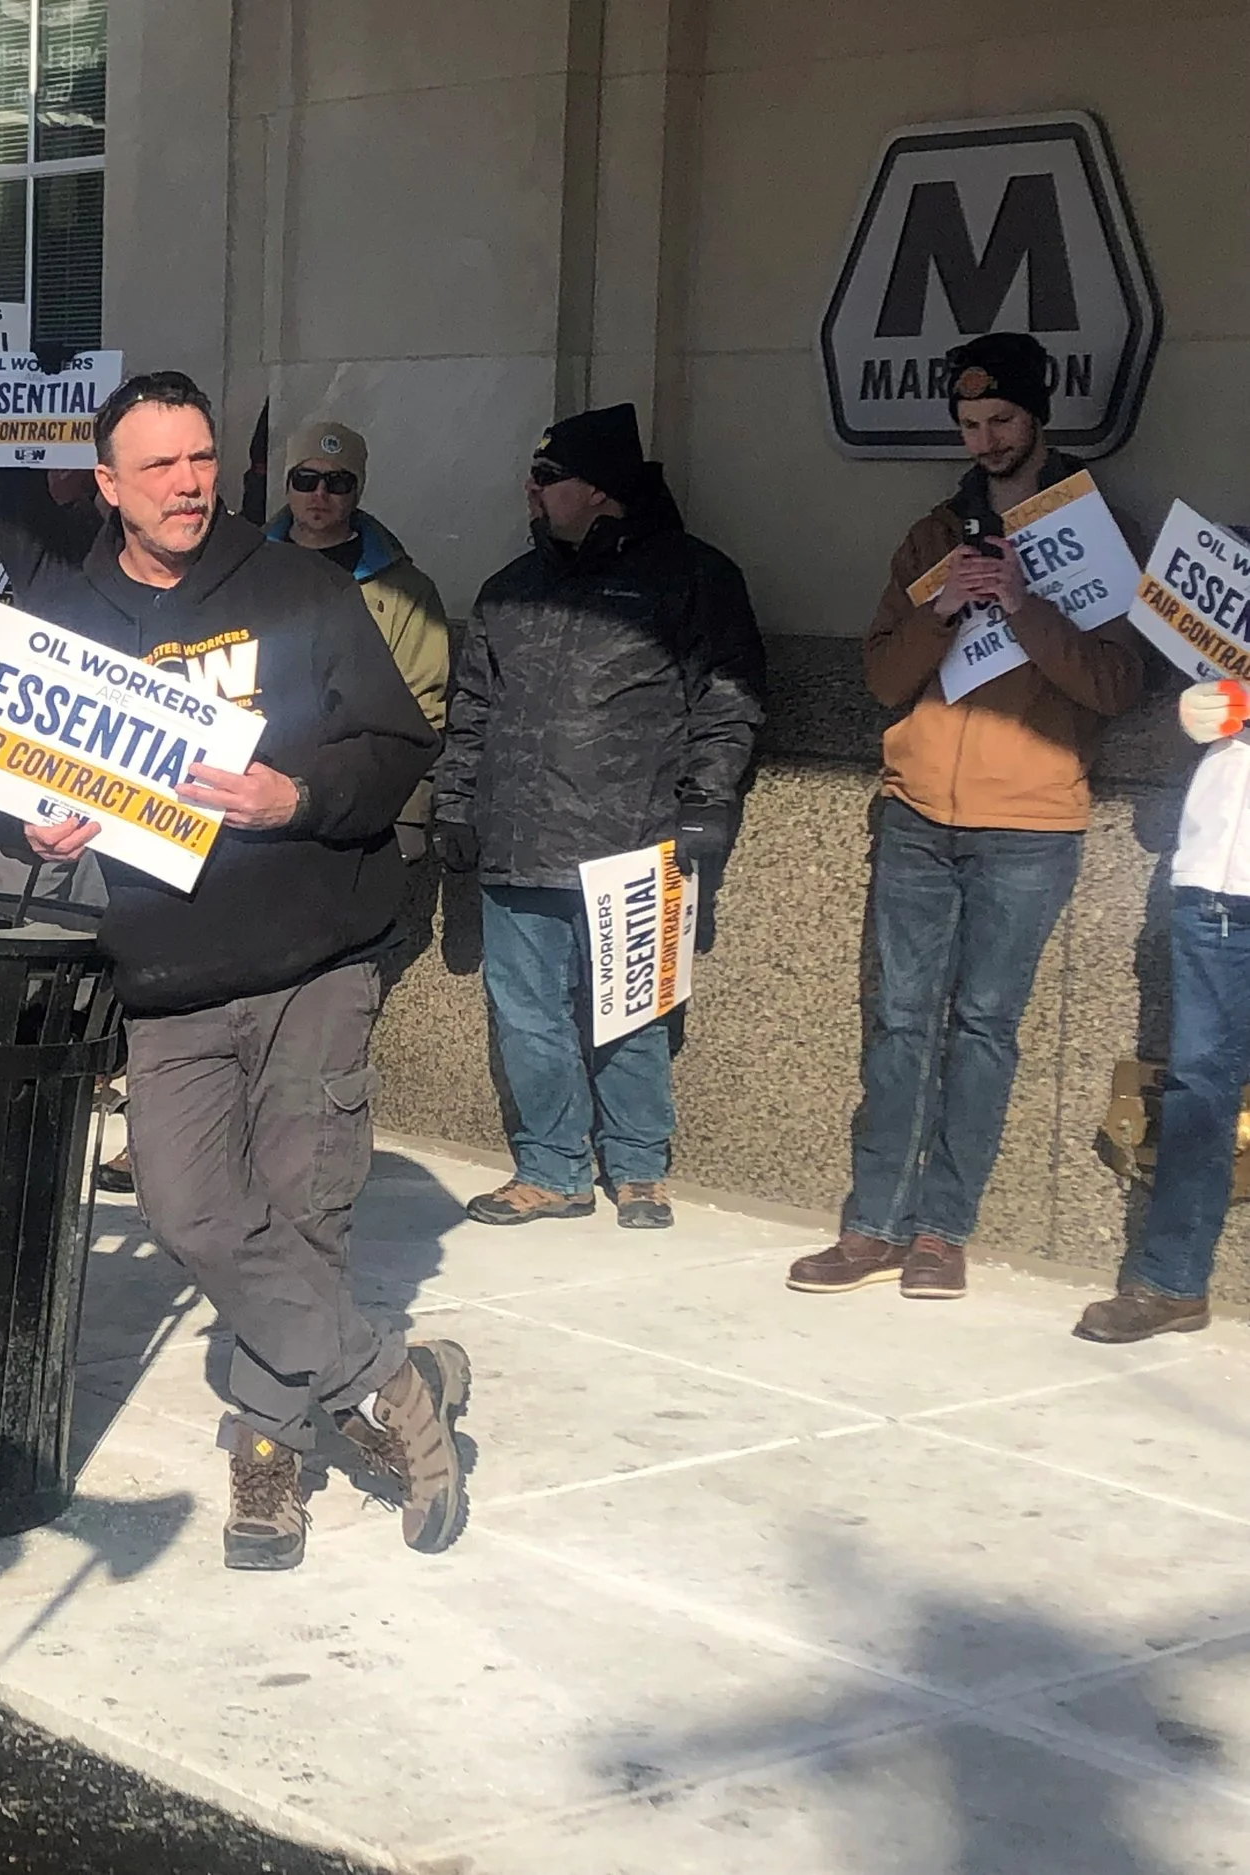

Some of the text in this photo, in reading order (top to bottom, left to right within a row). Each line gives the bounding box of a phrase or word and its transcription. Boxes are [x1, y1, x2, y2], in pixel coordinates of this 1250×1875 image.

[874, 172, 1081, 339] M
[11, 358, 93, 372] WOERS
[859, 353, 1093, 401] MARON
[71, 421, 95, 441] NO
[1197, 530, 1227, 562] OIL
[1142, 580, 1180, 622] FAIR
[962, 631, 1005, 666] FAIR
[28, 632, 217, 726] OIL WORKERS
[96, 686, 133, 709] ARE
[7, 741, 140, 814] CONTRACT
[137, 786, 209, 848] NOW!
[597, 893, 614, 1016] OIL WORKERS
[624, 867, 656, 1018] ESSENTIAL
[661, 896, 681, 974] CONTRACT
[659, 977, 676, 1010] FAIR
